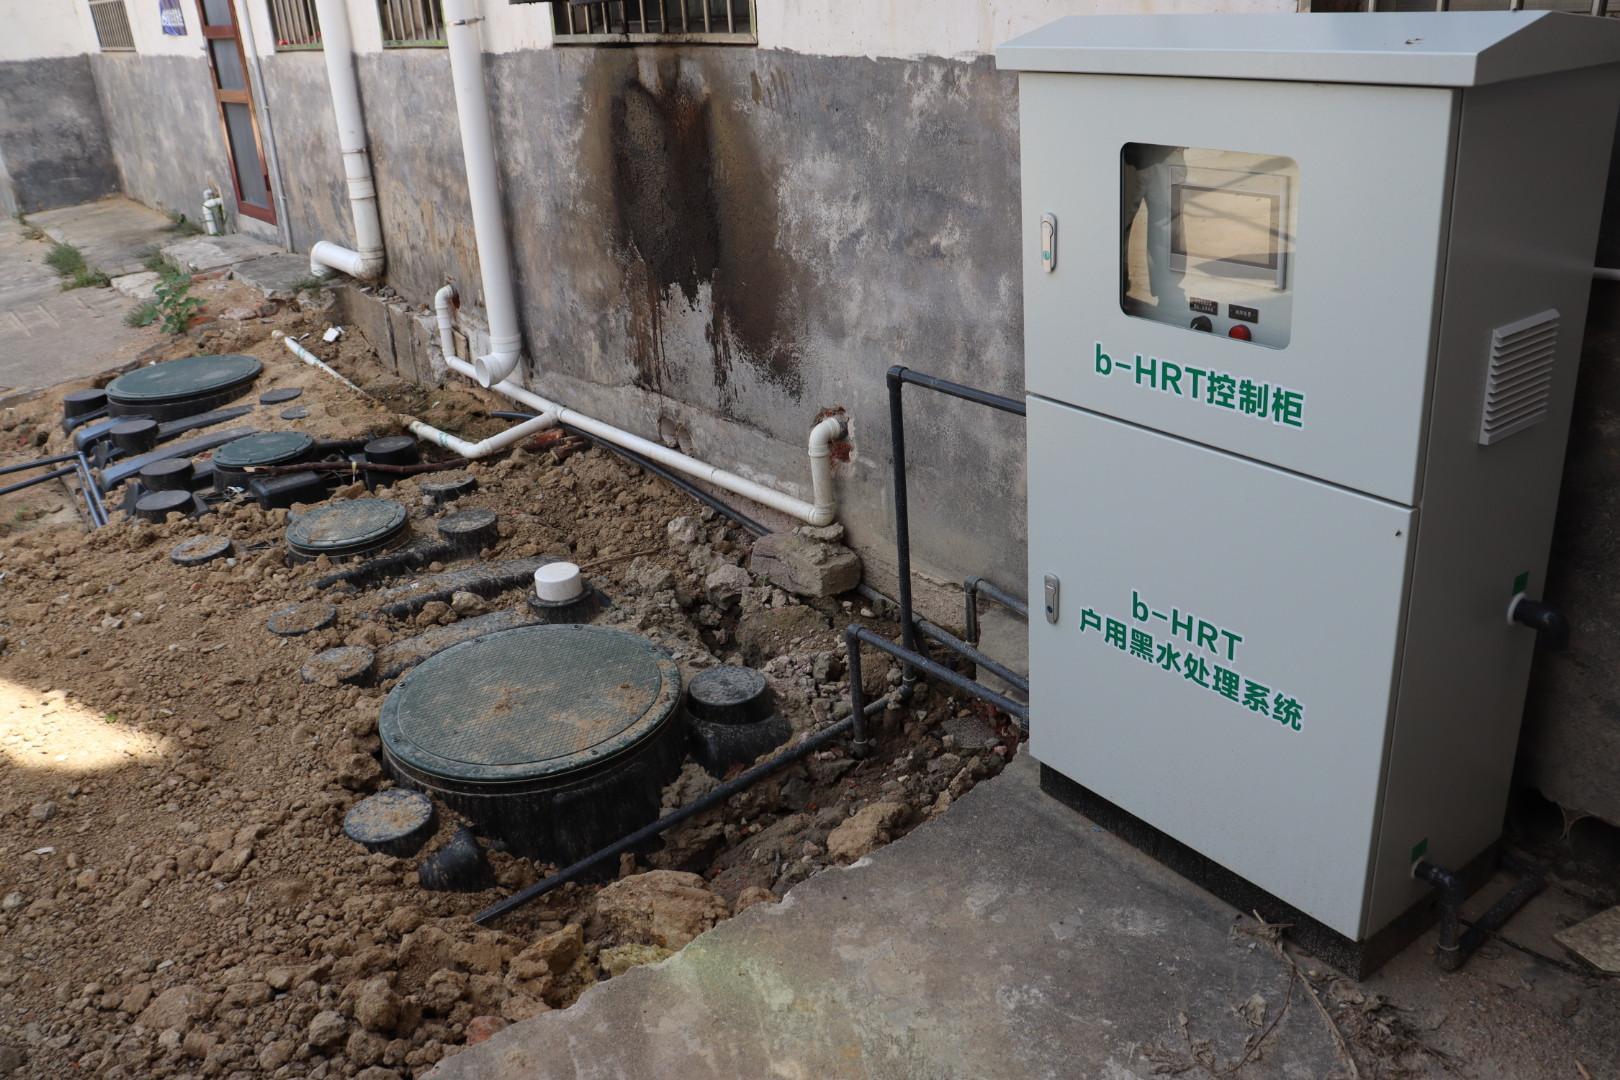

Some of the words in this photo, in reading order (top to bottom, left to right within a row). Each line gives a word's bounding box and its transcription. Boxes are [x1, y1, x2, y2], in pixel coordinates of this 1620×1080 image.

[1095, 343, 1304, 428] b-HRT控制柜
[1132, 591, 1243, 661] b-HRT
[1079, 608, 1304, 732] 户用黑水处理系统
